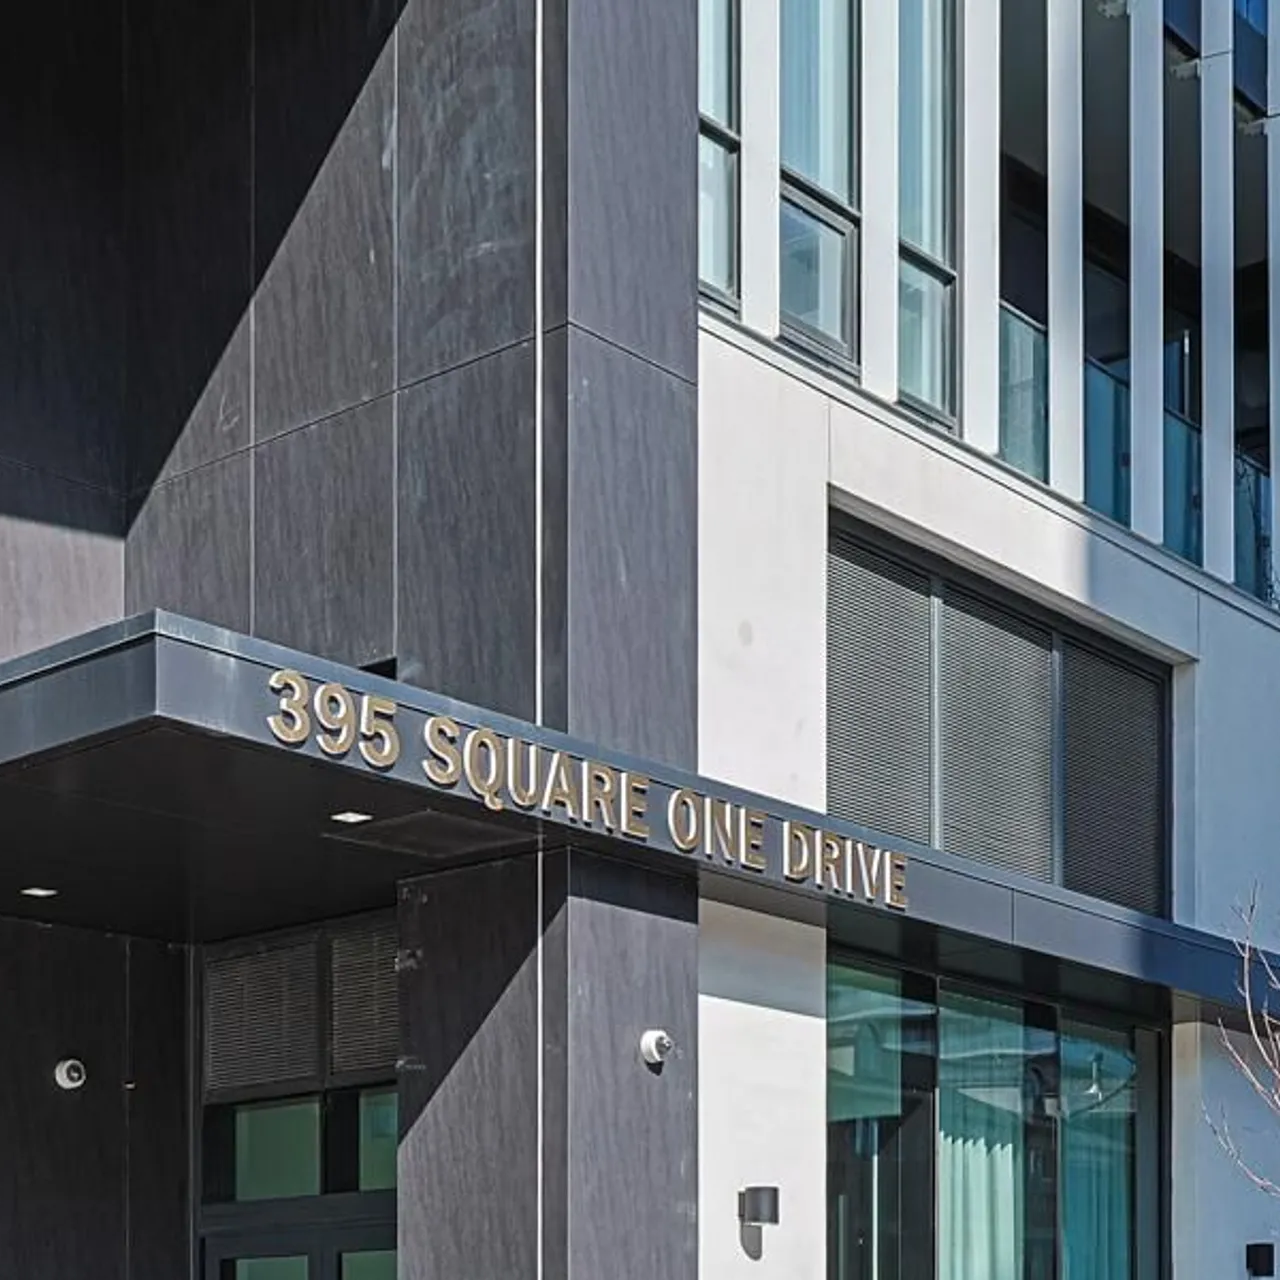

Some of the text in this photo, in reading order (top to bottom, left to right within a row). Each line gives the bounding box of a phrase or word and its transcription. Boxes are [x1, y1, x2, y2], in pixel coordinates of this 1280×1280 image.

[266, 668, 910, 911] 395 SQUARE ONE DRIVE
